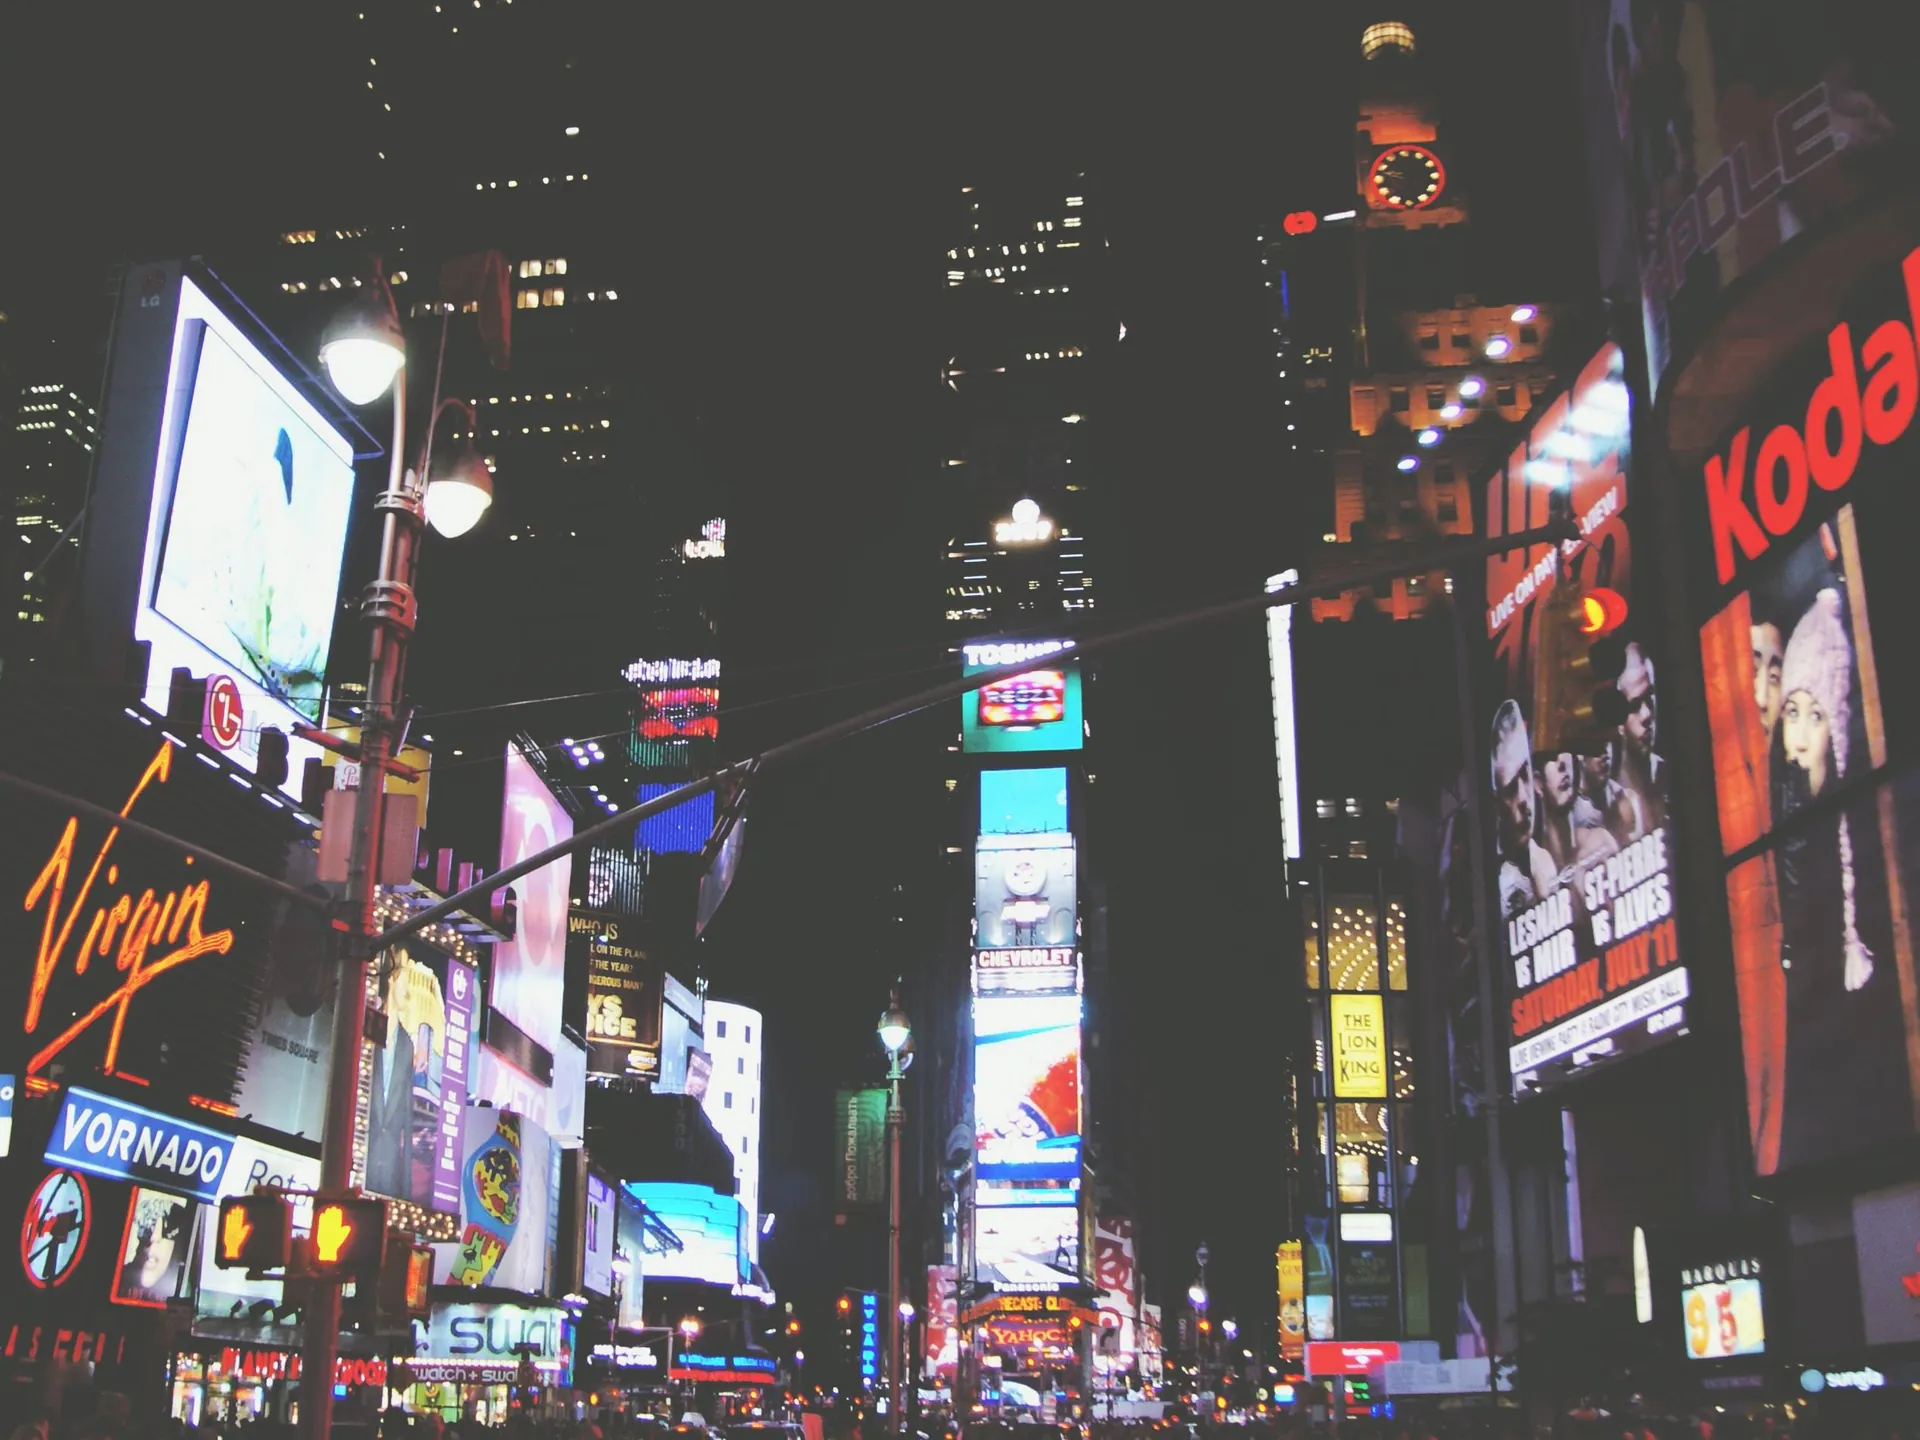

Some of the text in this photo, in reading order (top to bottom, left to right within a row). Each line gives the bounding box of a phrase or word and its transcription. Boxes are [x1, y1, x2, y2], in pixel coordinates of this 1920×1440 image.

[140, 294, 160, 308] LG
[1704, 246, 1920, 586] Koda
[1490, 592, 1515, 629] LIVE
[1515, 571, 1535, 604] ON
[1584, 827, 1668, 911] ST-PIERRE
[24, 740, 233, 1075] Virgin
[1613, 872, 1672, 940] ALVES
[1508, 888, 1573, 956] LESNAR
[609, 945, 623, 957] THE
[978, 948, 1073, 968] CHEVROLET
[1532, 928, 1576, 984] MIR
[1605, 929, 1651, 992] JULY
[1650, 917, 1678, 967] 11
[594, 959, 608, 971] THE
[1343, 1013, 1371, 1028] THE
[1339, 1033, 1378, 1055] LION
[1340, 1059, 1380, 1084] KING
[63, 1103, 223, 1184] VORNADO
[1681, 1258, 1761, 1285] MARQUIS
[993, 1280, 1060, 1292] Panasonic
[413, 1366, 466, 1382] watch
